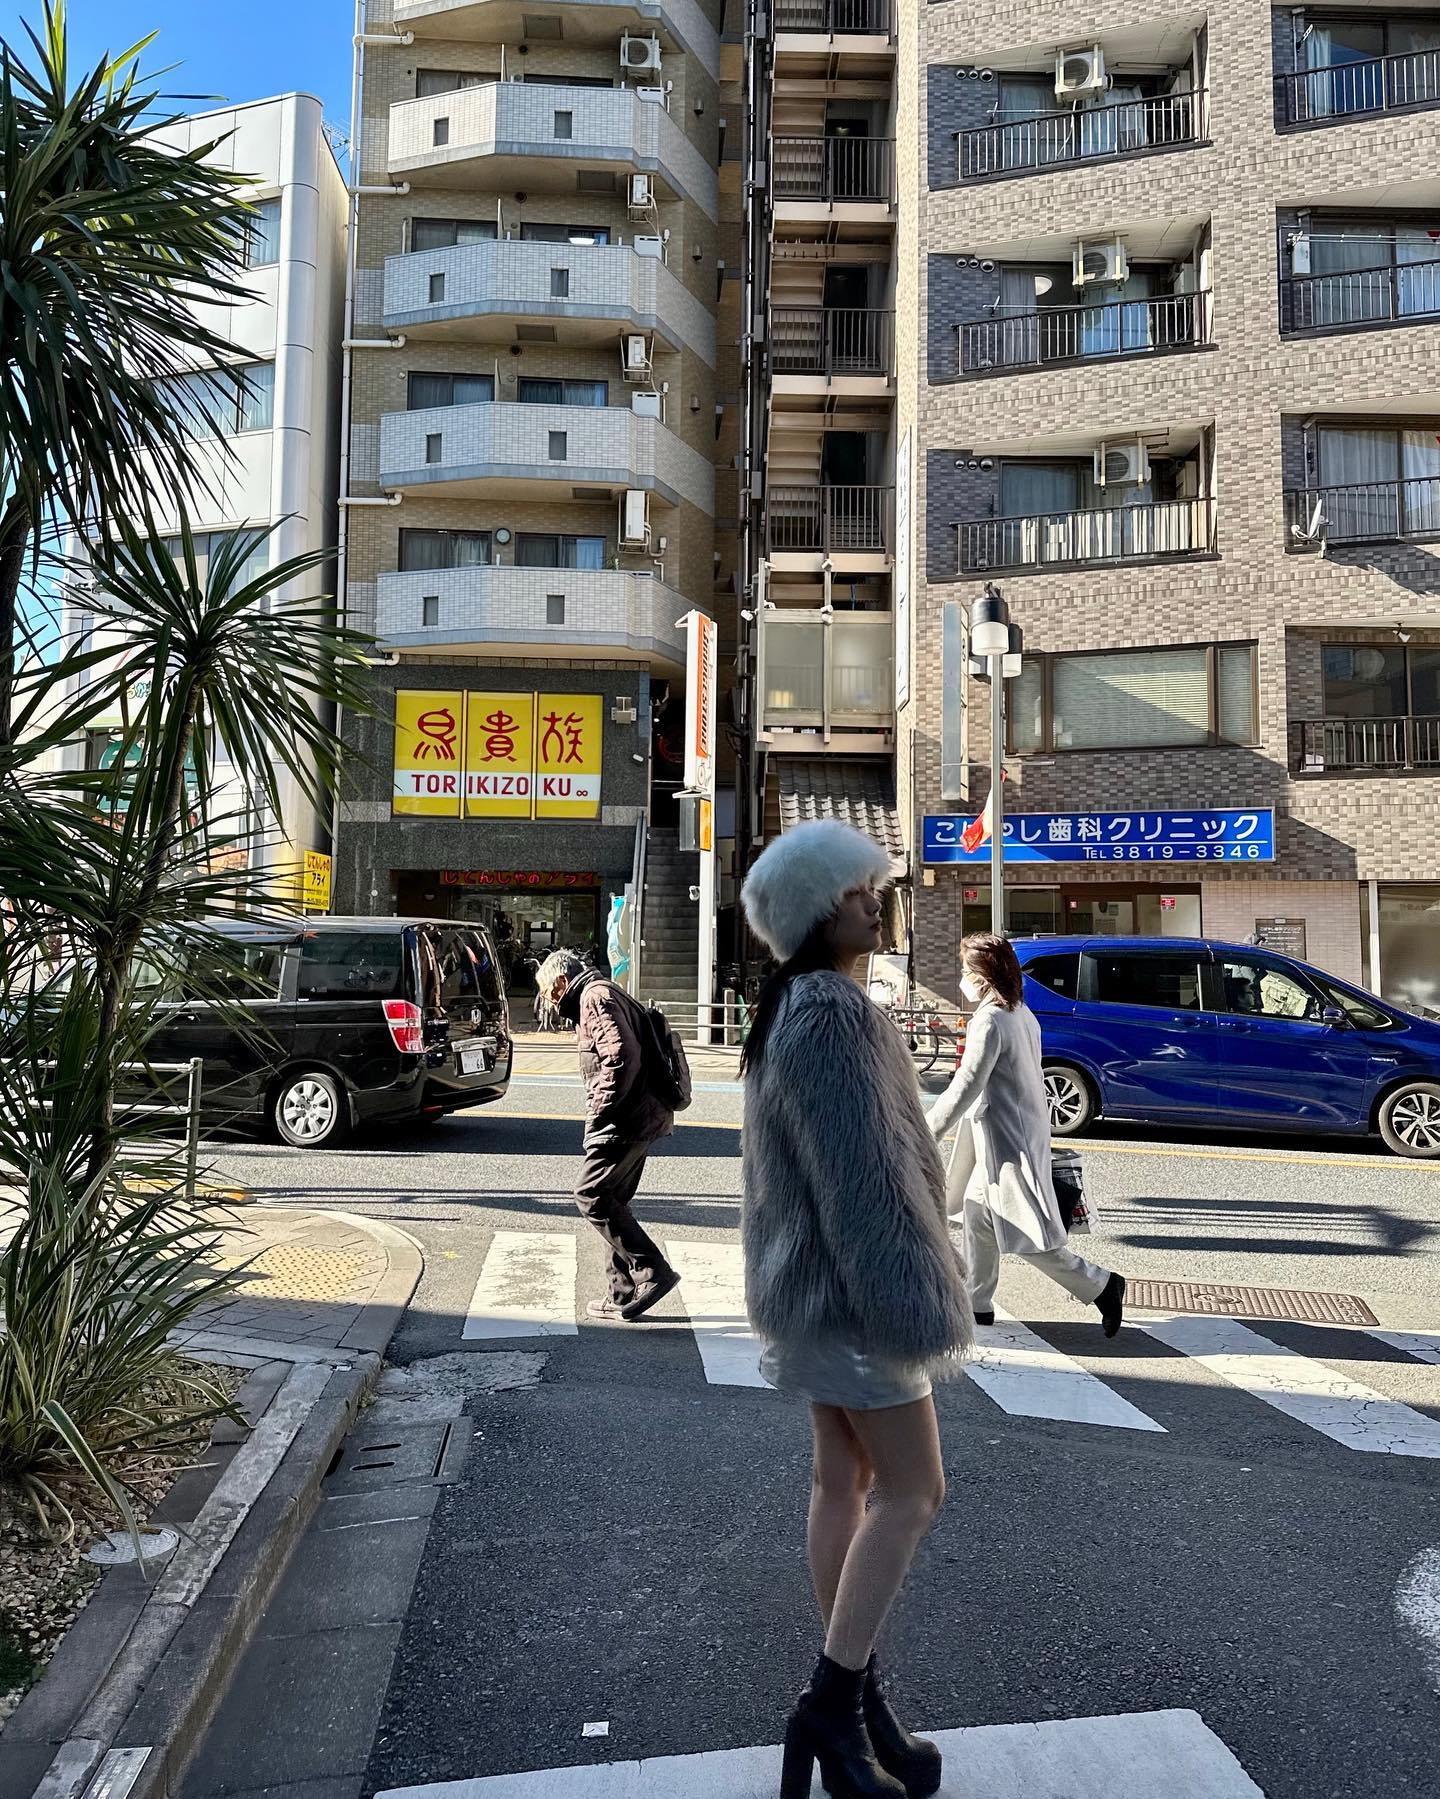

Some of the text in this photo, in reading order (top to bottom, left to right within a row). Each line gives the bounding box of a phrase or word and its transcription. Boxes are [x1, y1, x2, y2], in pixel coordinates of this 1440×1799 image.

[413, 708, 584, 763] 鳥貴族
[935, 815, 1258, 842] こし歯科クリニック
[1112, 845, 1260, 858] 3819-3346
